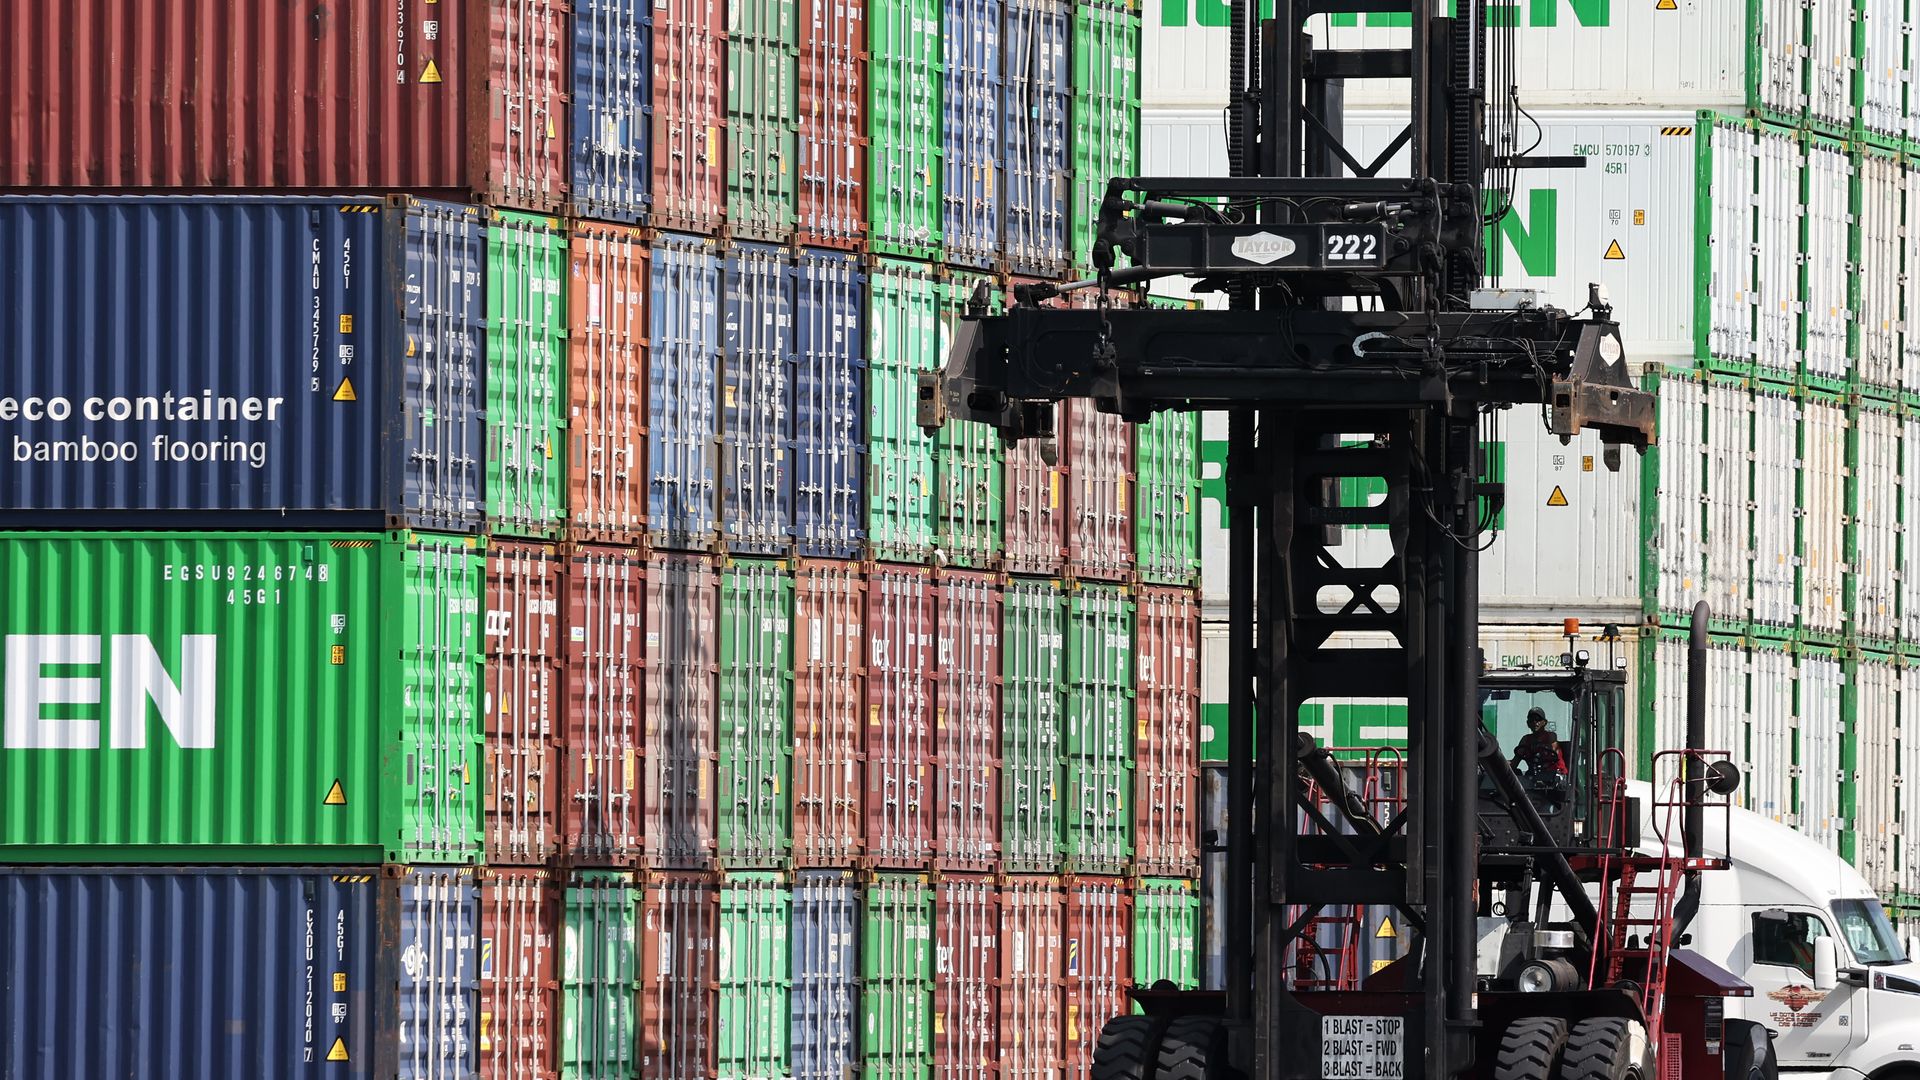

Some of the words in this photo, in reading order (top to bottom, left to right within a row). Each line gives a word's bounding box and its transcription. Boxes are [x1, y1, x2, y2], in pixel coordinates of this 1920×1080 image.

[1573, 144, 1600, 156] EMCU
[1606, 144, 1640, 156] 570197
[1605, 163, 1627, 174] 45R1
[1237, 238, 1291, 253] TAYLOR
[1328, 234, 1377, 260] 222
[312, 238, 320, 290] CMAU
[312, 296, 320, 372] 345729
[0, 396, 72, 421] eco
[83, 389, 284, 421] container
[13, 435, 138, 462] bamboo
[152, 435, 266, 469] flooring
[227, 589, 280, 604] 45G1
[872, 629, 889, 667] tex
[938, 629, 954, 665] tex
[1139, 645, 1156, 681] tex
[4, 634, 217, 749] EN
[936, 936, 954, 974] tex
[1333, 1019, 1363, 1035] BLAST
[1376, 1019, 1400, 1035] STOP
[1324, 1040, 1330, 1055] 2
[1333, 1040, 1363, 1056] BLAST
[1376, 1040, 1397, 1056] FWD
[1324, 1061, 1330, 1076] 3
[1333, 1061, 1362, 1077] BLAST
[1376, 1061, 1401, 1077] BACK
